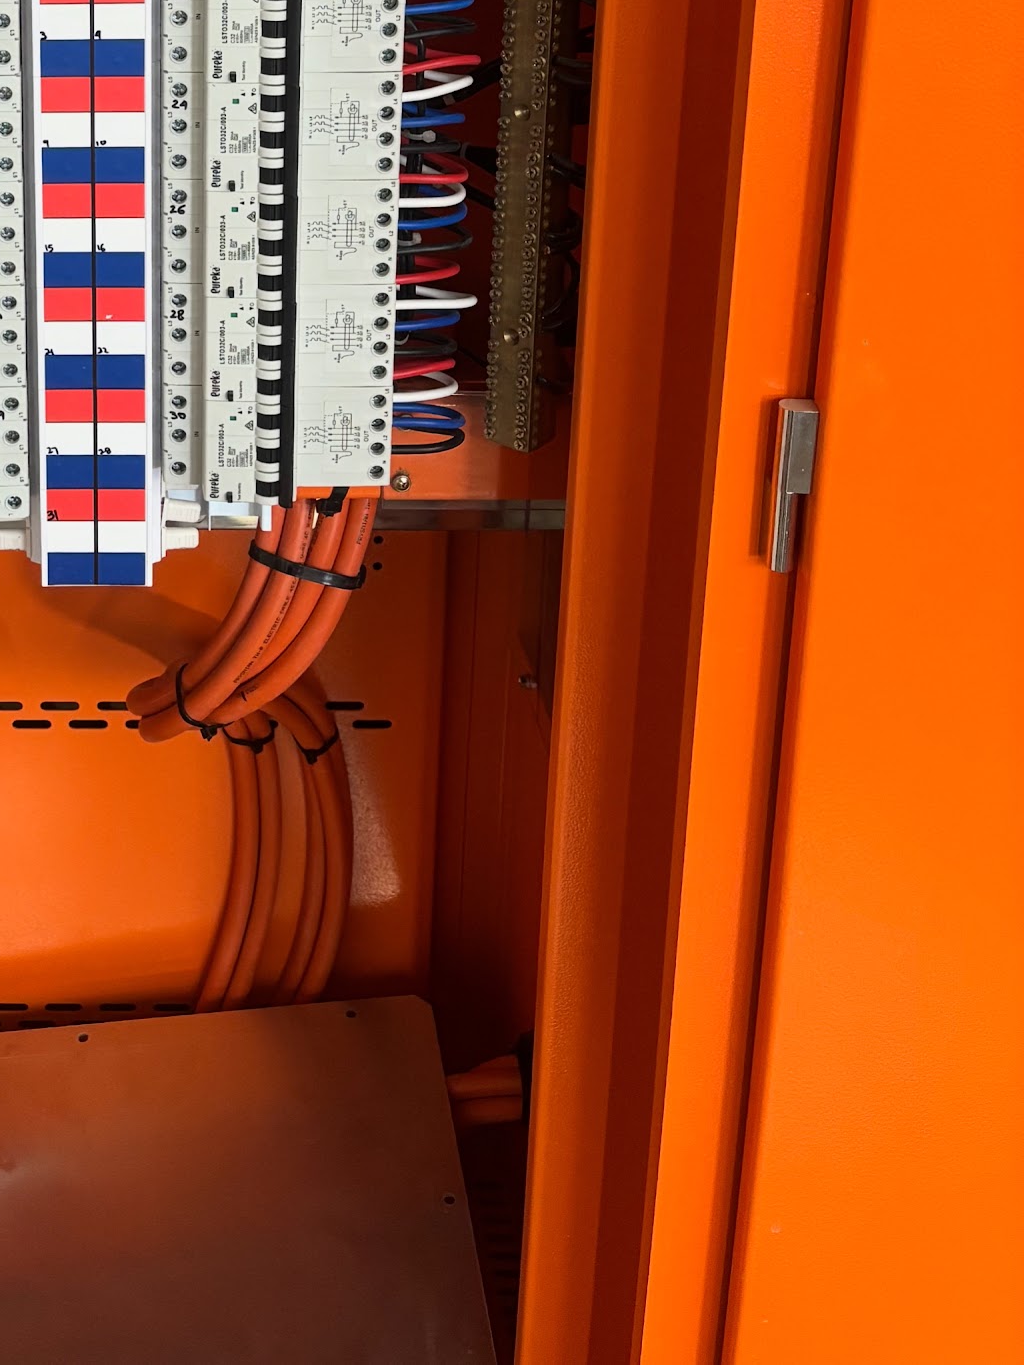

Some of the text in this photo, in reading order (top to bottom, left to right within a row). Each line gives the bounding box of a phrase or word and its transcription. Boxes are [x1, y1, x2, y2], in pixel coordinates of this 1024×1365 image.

[39, 31, 48, 41] 3
[171, 99, 188, 110] 24
[42, 139, 50, 148] 9
[169, 204, 186, 215] 26
[44, 244, 54, 253] 15
[97, 243, 106, 252] 16
[169, 309, 185, 321] 28
[169, 410, 187, 420] 30
[46, 446, 59, 455] 27
[98, 447, 112, 455] 28
[46, 509, 59, 521] 31
